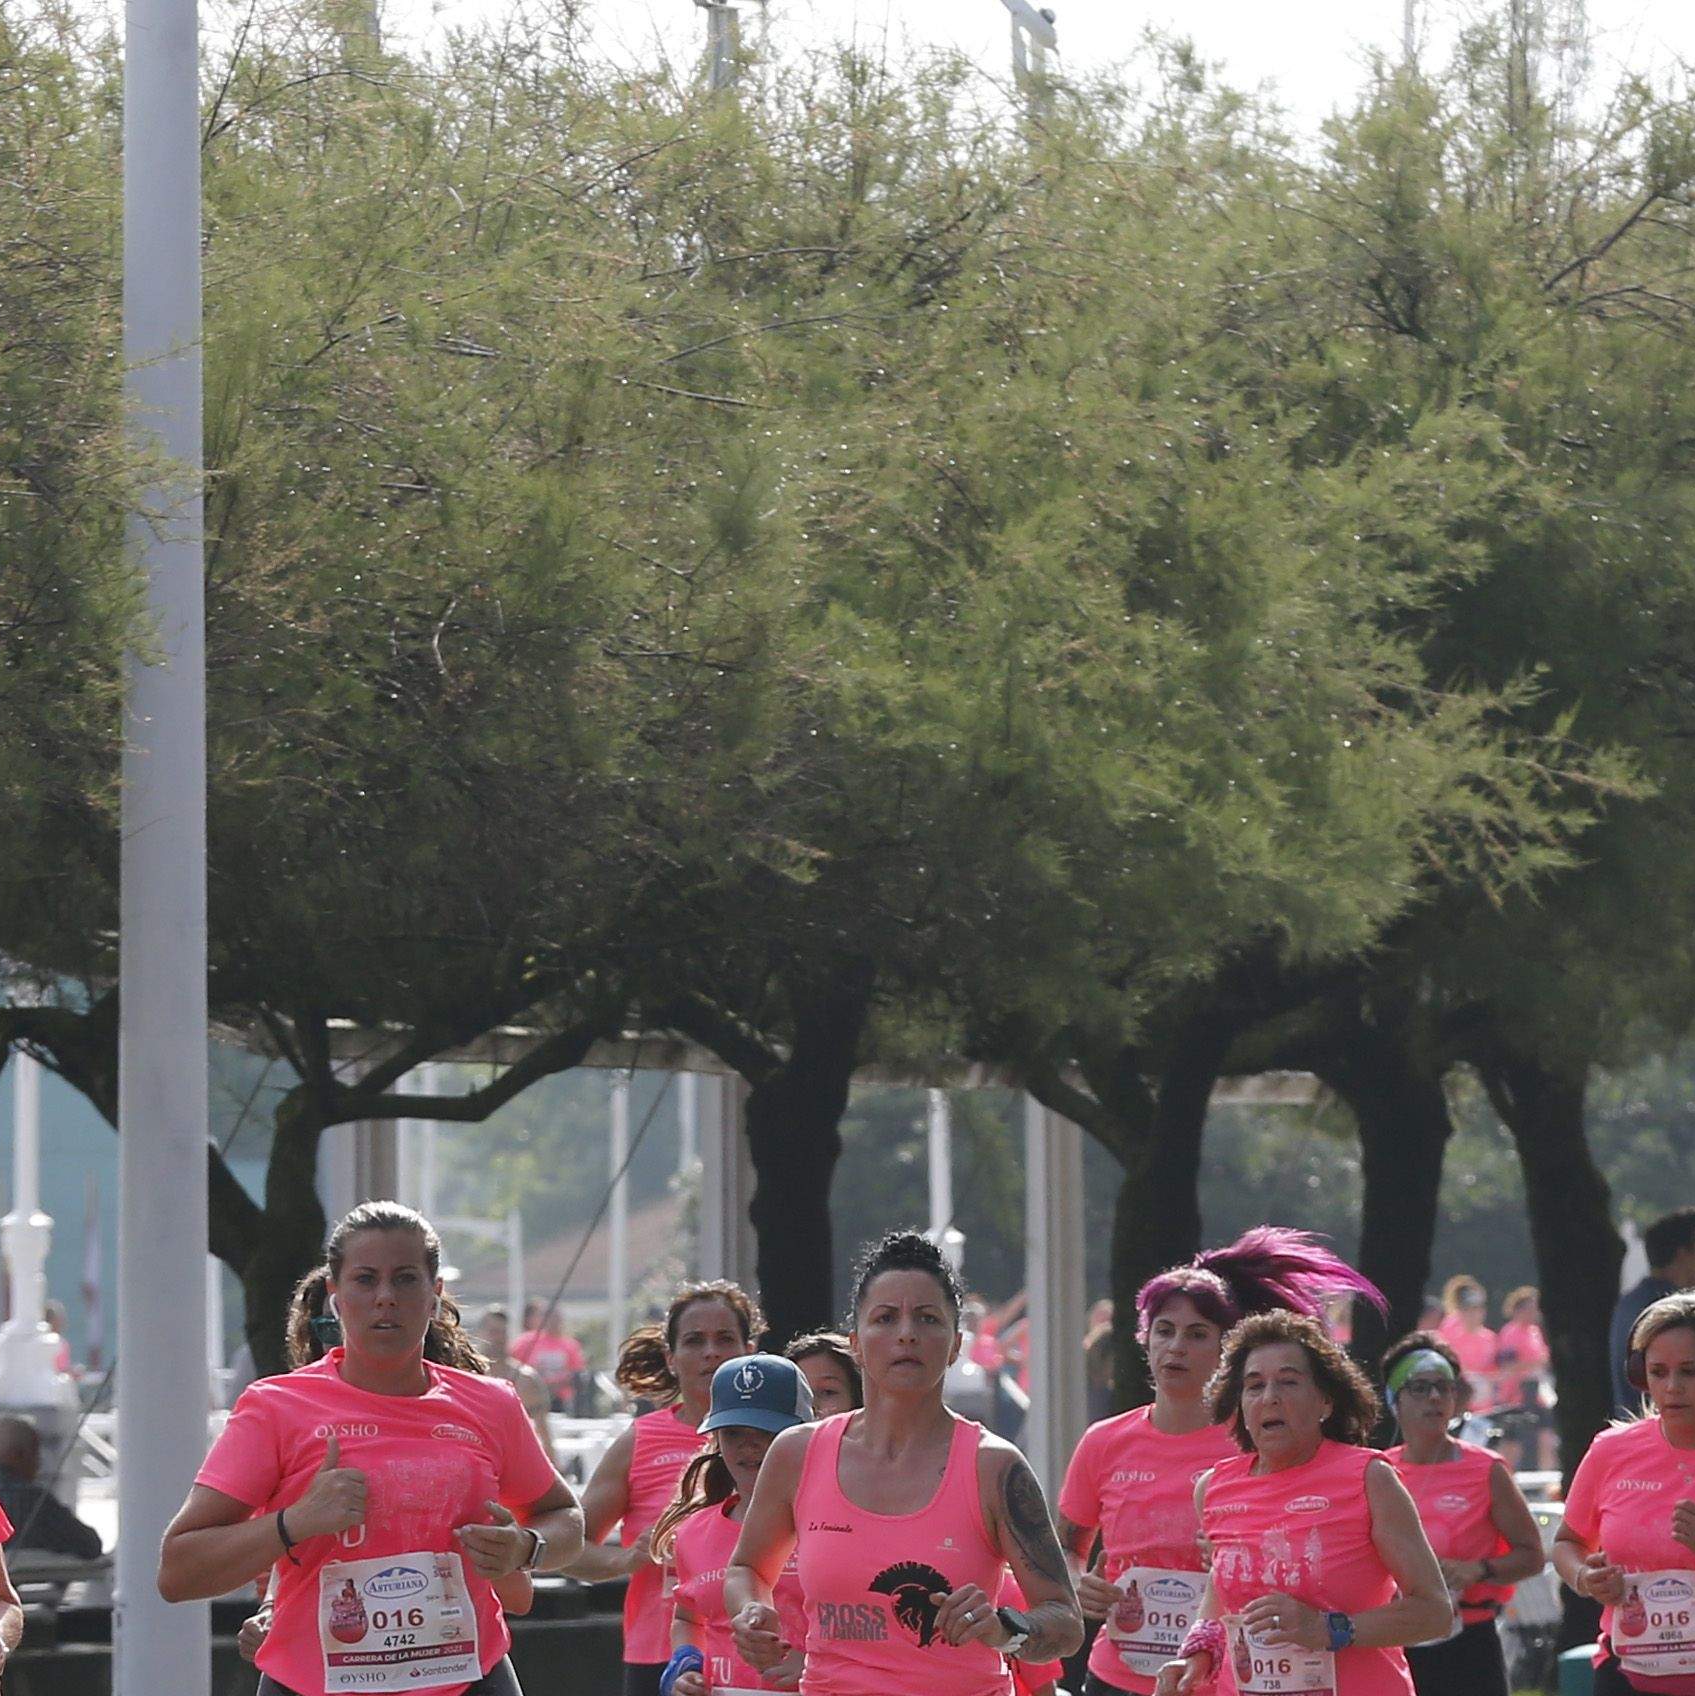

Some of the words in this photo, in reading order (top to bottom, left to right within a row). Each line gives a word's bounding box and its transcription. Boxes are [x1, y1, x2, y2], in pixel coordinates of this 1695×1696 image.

[314, 1423, 379, 1439] OYSHO
[1616, 1478, 1663, 1492] OYSHO
[368, 1579, 424, 1594] ASTURIANA
[1149, 1586, 1192, 1599] ASTURIANA
[372, 1608, 425, 1630] 016
[817, 1601, 888, 1630] CROSS
[1147, 1611, 1188, 1629] 016
[1650, 1611, 1690, 1627] 016
[818, 1623, 889, 1641] TRAINING
[1153, 1630, 1179, 1642] 3514
[384, 1633, 416, 1648] 4742
[342, 1653, 385, 1664] CARRERA
[385, 1652, 399, 1662] DE
[398, 1651, 410, 1660] LA
[410, 1647, 441, 1659] MUJER
[422, 1662, 468, 1676] Santander
[1254, 1658, 1292, 1675] 016
[340, 1671, 387, 1684] OYSHO
[1263, 1680, 1281, 1689] 738
